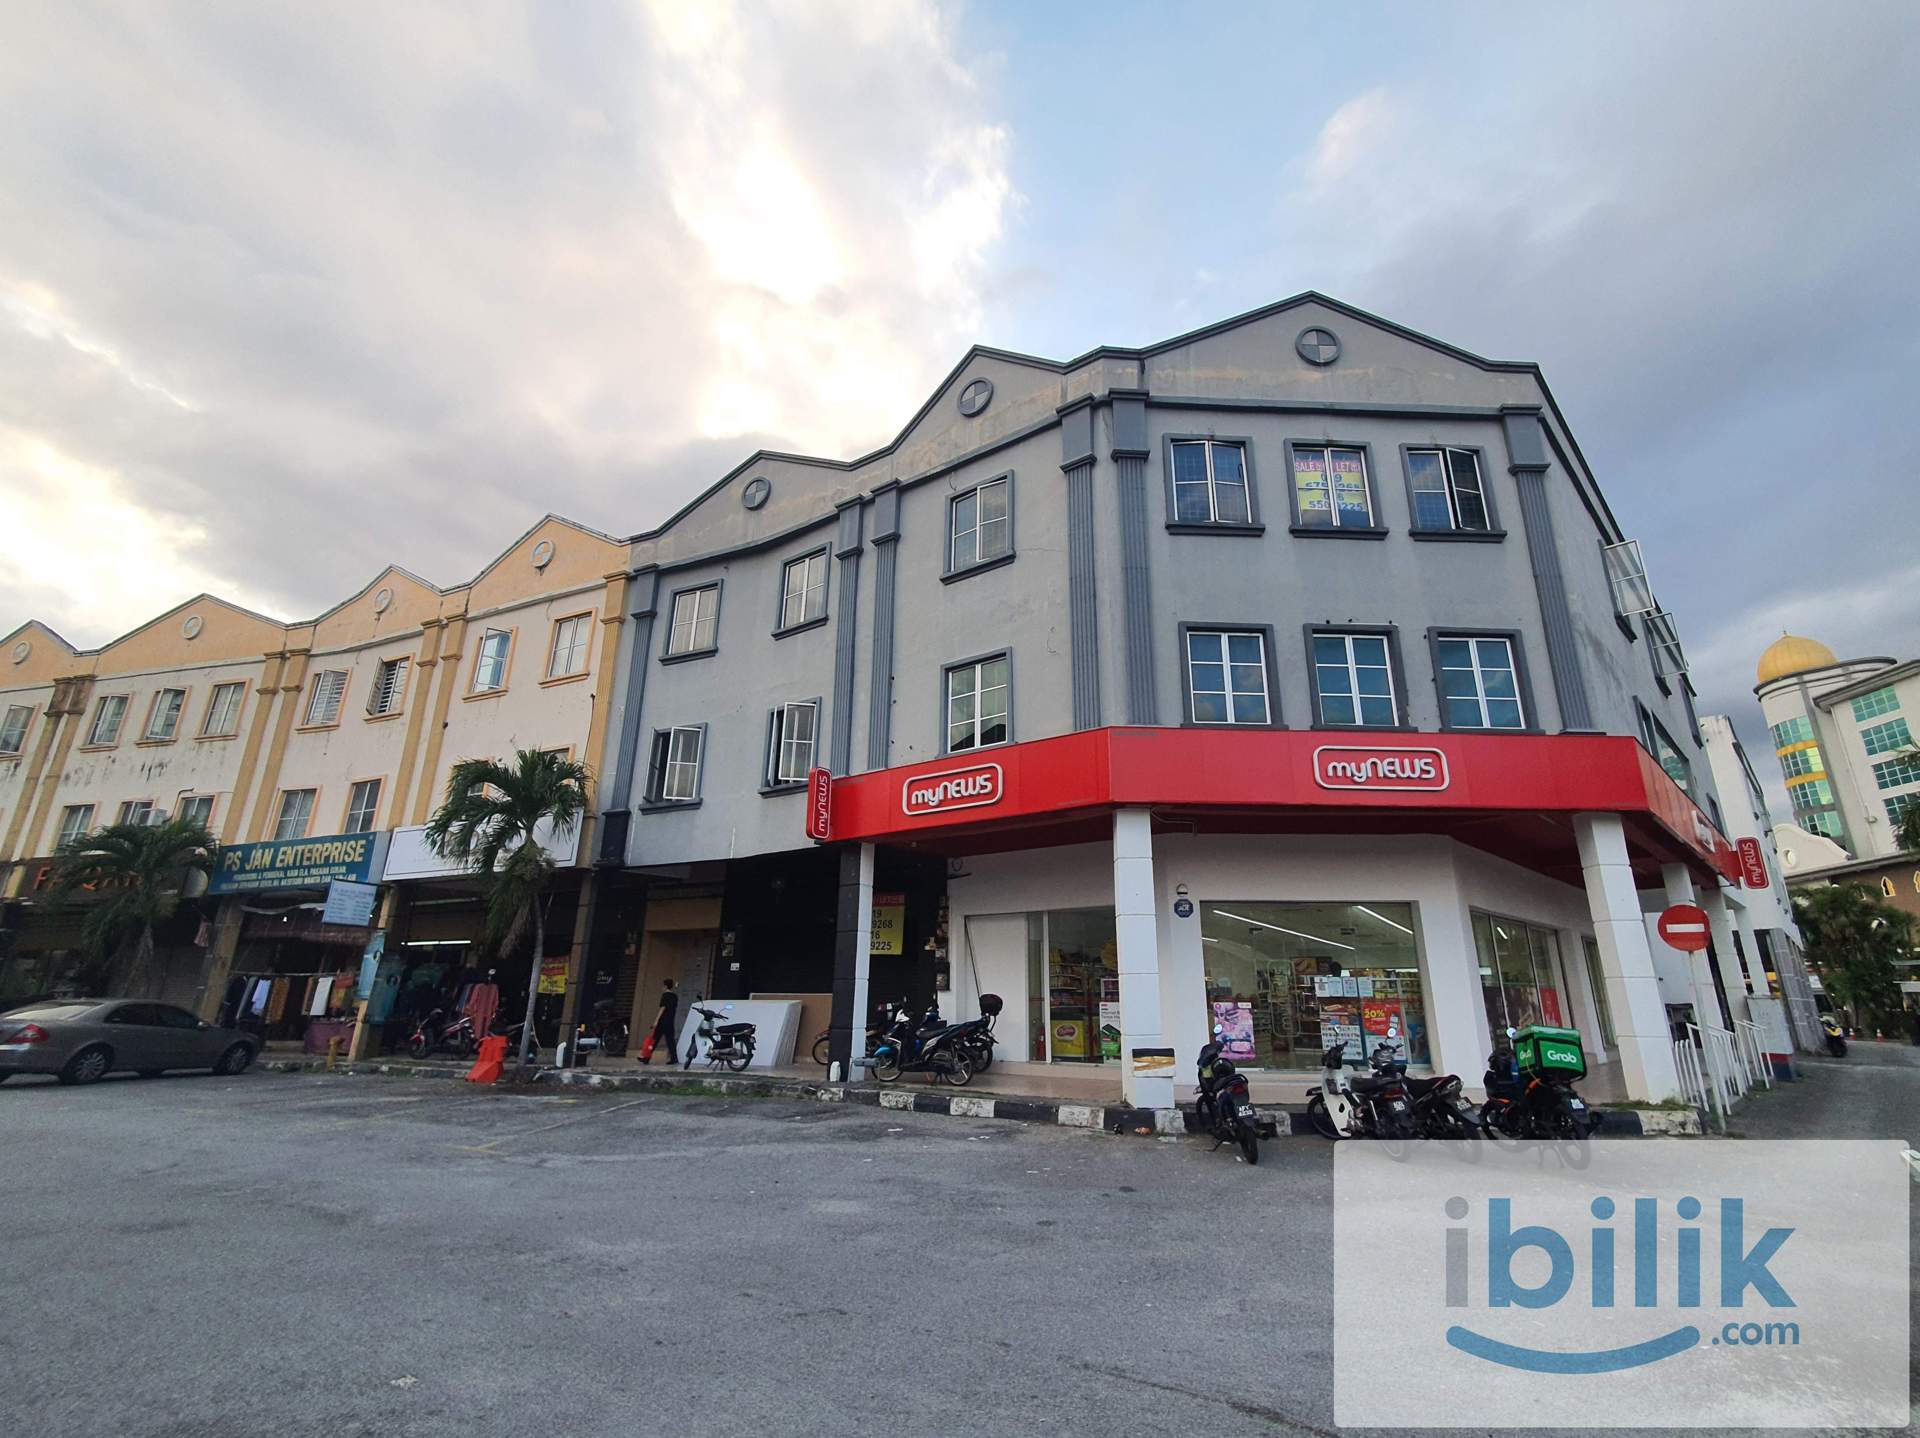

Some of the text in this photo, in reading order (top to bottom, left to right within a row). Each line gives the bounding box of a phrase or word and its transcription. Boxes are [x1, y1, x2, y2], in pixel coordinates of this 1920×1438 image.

[1295, 461, 1314, 471] SALE
[1336, 461, 1349, 472] LET
[224, 839, 366, 871] PS JAN ENTERPRISE
[1364, 1008, 1385, 1019] 20%
[1546, 1050, 1577, 1064] Grab
